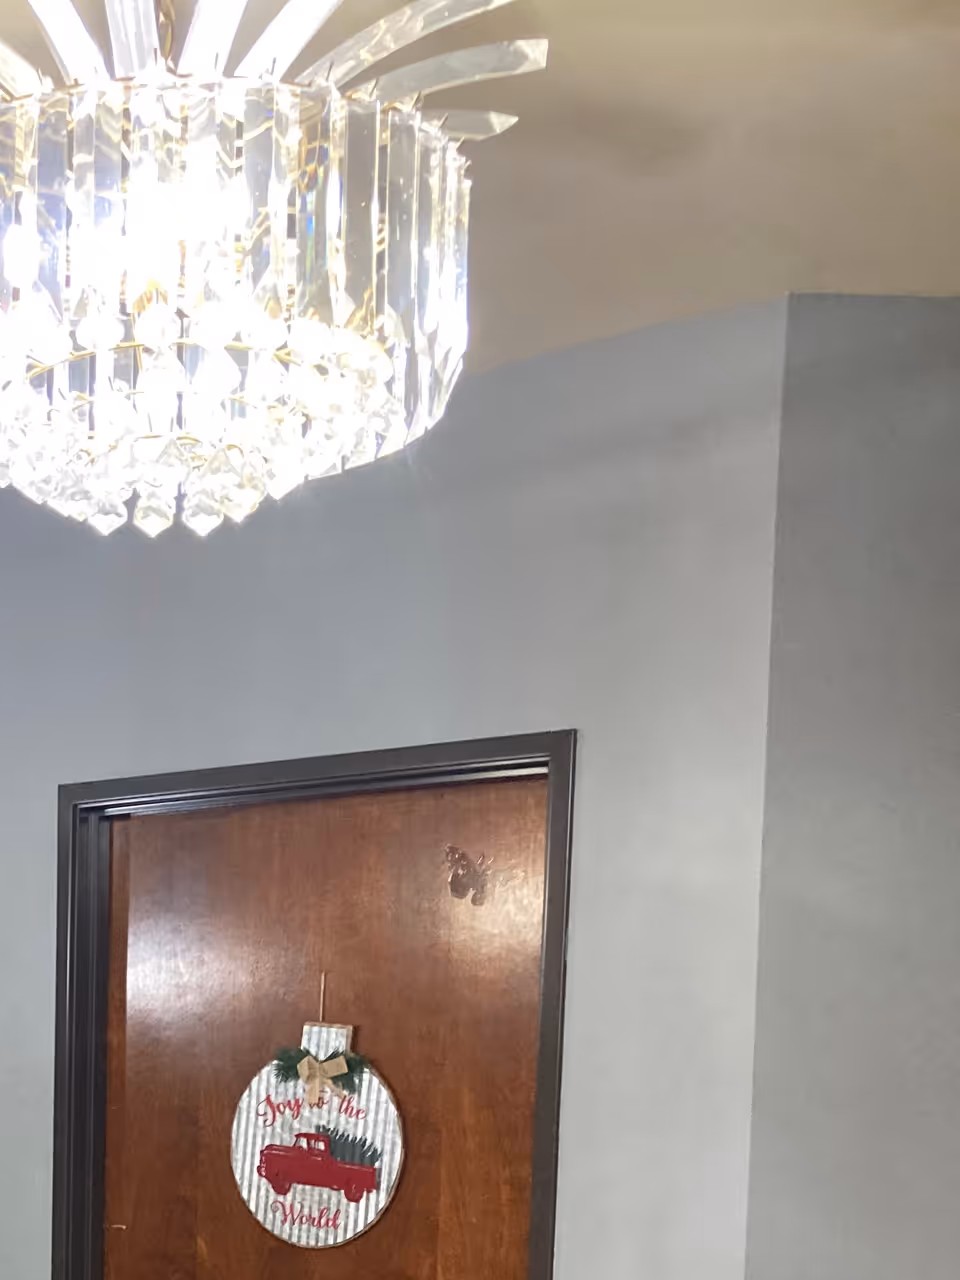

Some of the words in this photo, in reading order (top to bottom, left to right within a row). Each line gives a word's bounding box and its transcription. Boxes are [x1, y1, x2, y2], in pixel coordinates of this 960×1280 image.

[256, 1094, 304, 1128] Joy
[338, 1094, 368, 1120] the
[270, 1200, 342, 1231] World
